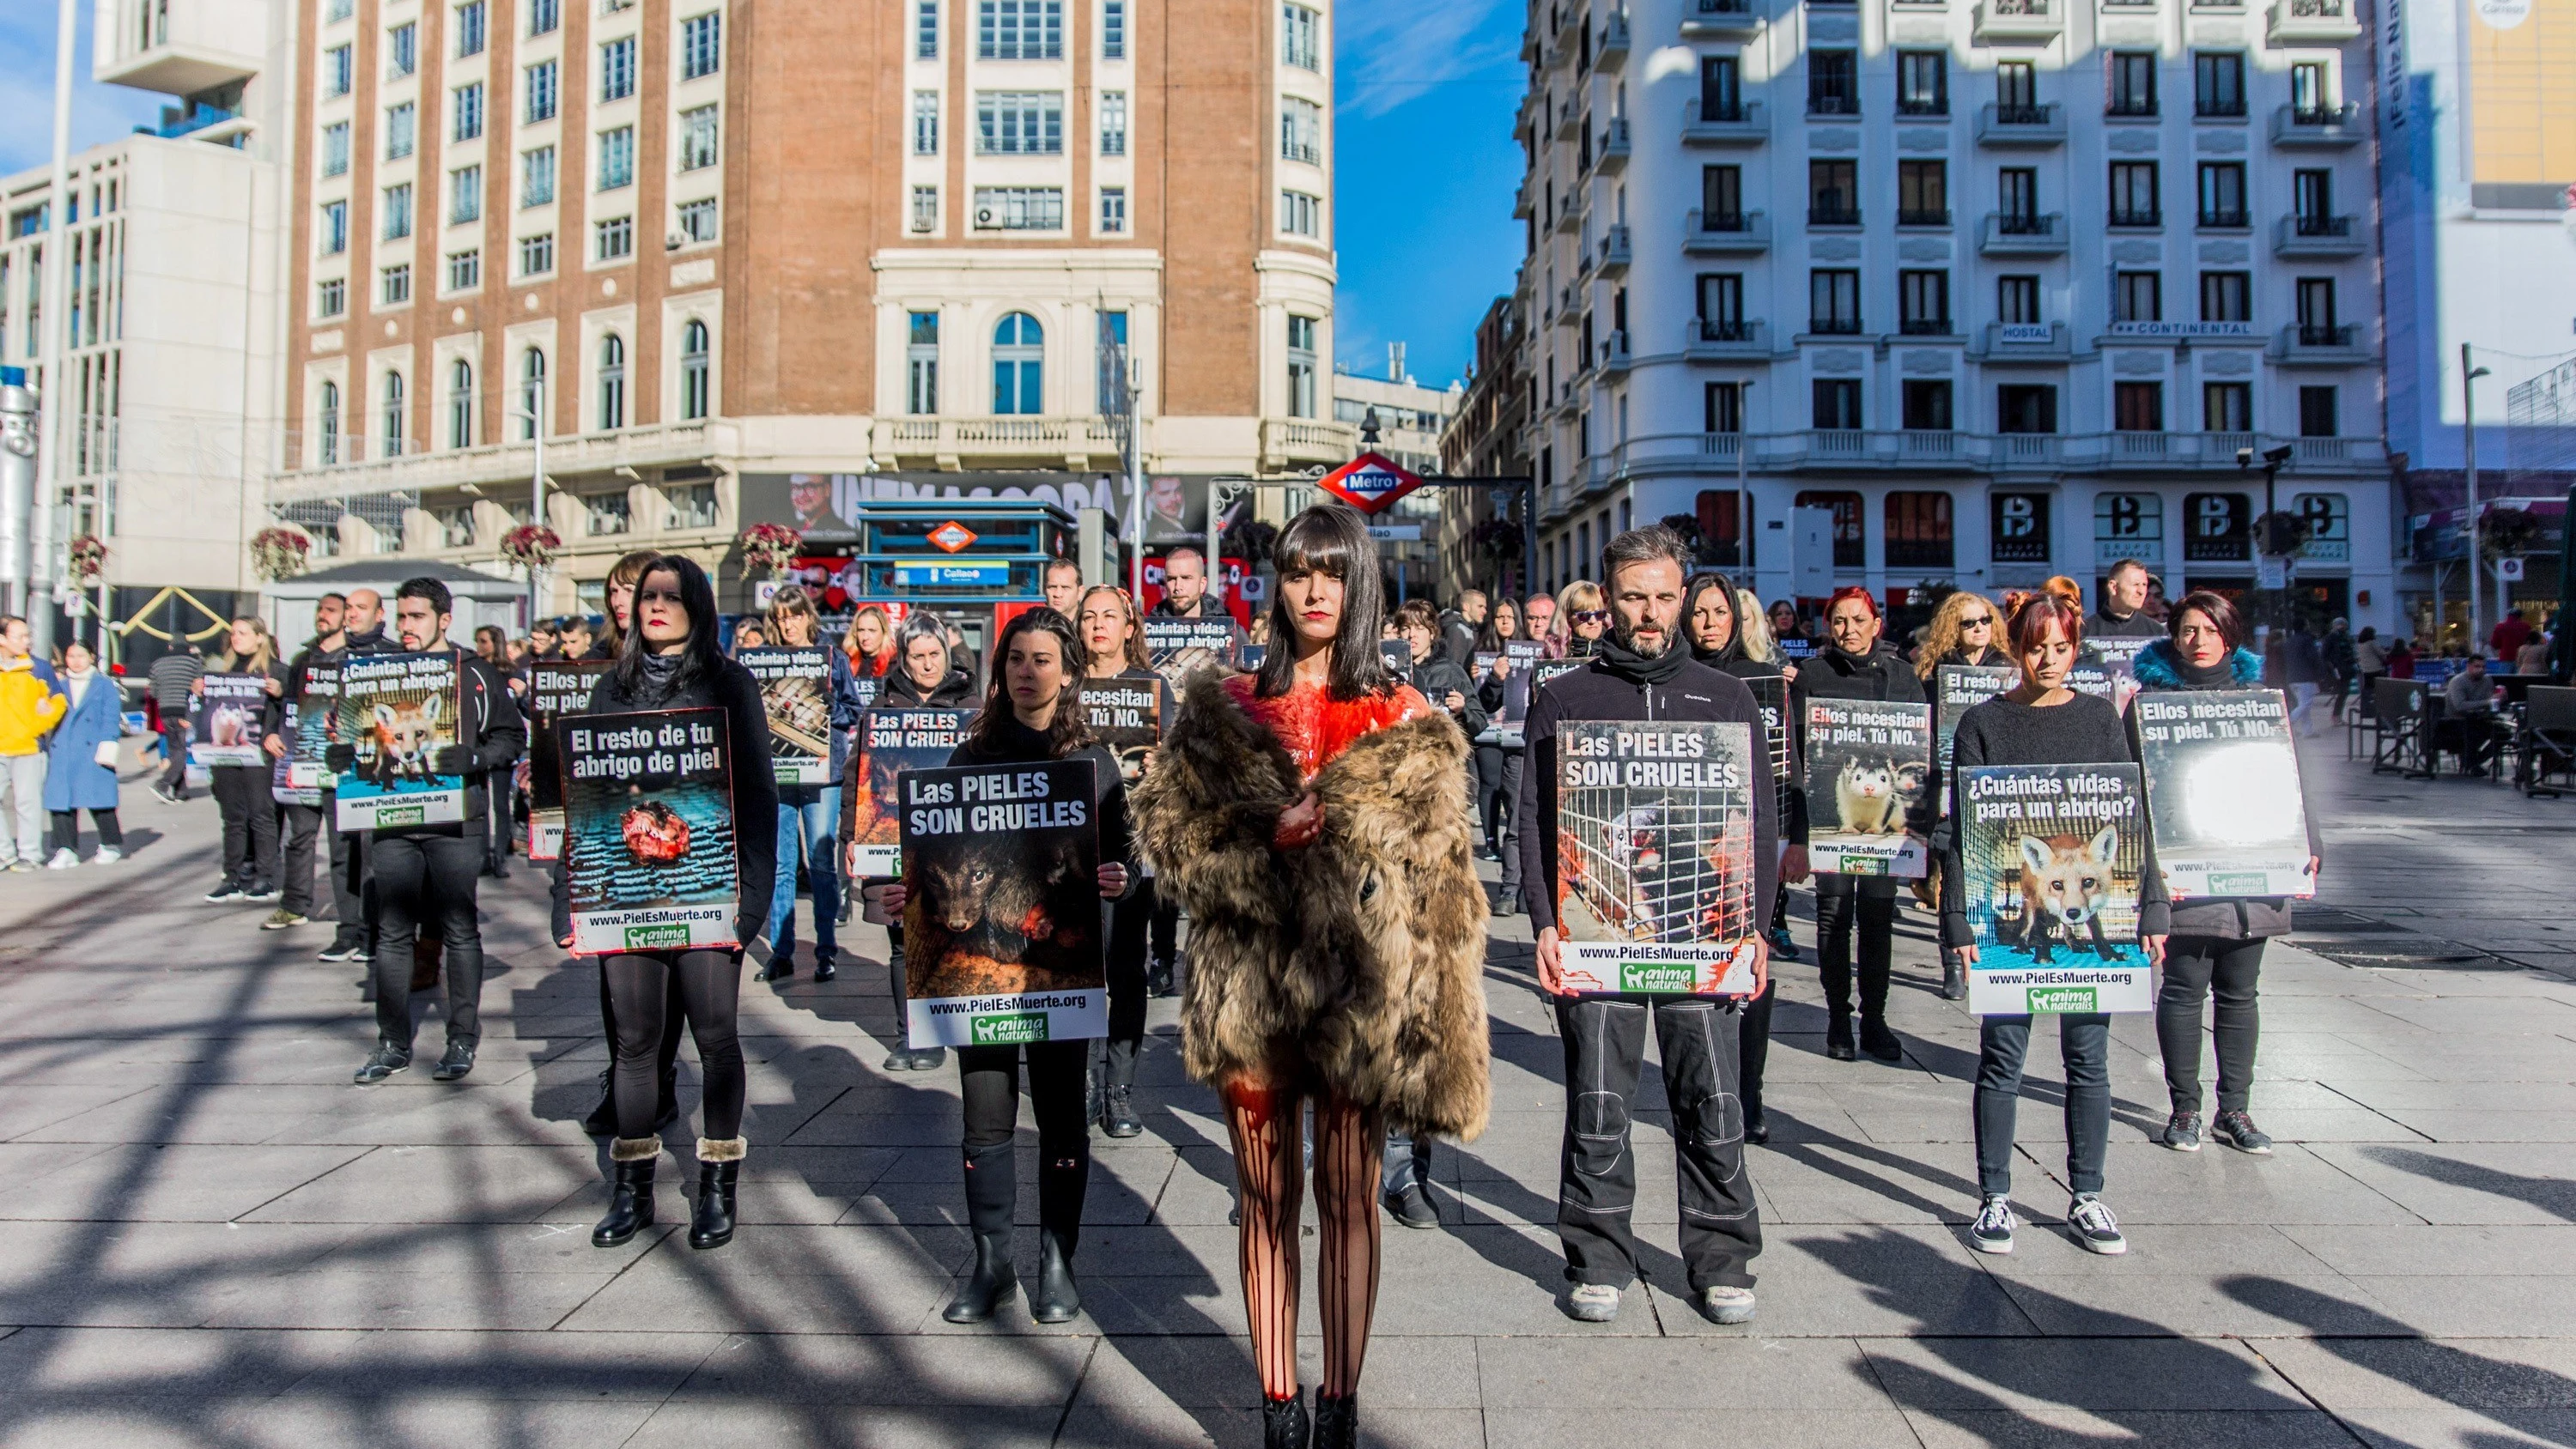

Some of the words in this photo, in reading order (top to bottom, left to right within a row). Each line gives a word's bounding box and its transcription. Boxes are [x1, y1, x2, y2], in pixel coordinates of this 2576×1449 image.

[2003, 327, 2049, 338] HOSTAL
[2138, 323, 2250, 334] CONTINENTAL
[1350, 476, 1393, 488] Metro
[1995, 543, 2044, 551] GRUPO
[1145, 622, 1191, 635] Cuántas
[1194, 621, 1226, 634] vidas
[1167, 637, 1183, 648] un
[1187, 635, 1233, 651] abrigo?
[1509, 645, 1534, 656] Ellos
[739, 652, 790, 668] ¿Cuántas
[792, 652, 823, 664] vidas
[341, 663, 407, 684] ¿Cuántas
[408, 658, 448, 674] vidas
[769, 667, 783, 677] un
[786, 664, 829, 678] abrigo?
[2074, 670, 2104, 681] vidas
[345, 681, 378, 698] para
[380, 678, 399, 691] un
[402, 671, 456, 691] abrigo?
[536, 671, 578, 690] Ellos
[1947, 673, 1961, 687] El
[1964, 675, 2001, 689] resto
[535, 694, 557, 711] su
[2142, 702, 2188, 720] Ellos
[2192, 700, 2282, 718] necesitan
[870, 713, 899, 730] Las
[902, 713, 958, 730] PIELES
[1090, 708, 1109, 727] Tú
[1114, 708, 1144, 727] NO.
[1810, 706, 1848, 724] Ellos
[1851, 710, 1926, 729] necesitan
[571, 729, 592, 752] El
[598, 727, 653, 750] resto
[659, 724, 685, 747] de
[690, 722, 714, 744] tu
[1809, 726, 1829, 741] su
[1832, 727, 1867, 745] piel.
[1868, 728, 1886, 743] Tú
[1891, 730, 1917, 746] NO.
[2145, 726, 2169, 741] su
[2173, 721, 2215, 743] piel.
[2216, 720, 2239, 738] Tú
[2243, 719, 2275, 737] NO.
[868, 731, 902, 748] SON
[1565, 732, 1610, 757] Las
[1617, 732, 1704, 758] PIELES
[574, 751, 642, 779] abrigo
[647, 749, 676, 773] de
[680, 747, 720, 776] piel
[1565, 761, 1618, 786] SON
[1625, 761, 1740, 789] CRUELES
[909, 779, 953, 805] Las
[962, 772, 1049, 803] PIELES
[1969, 776, 2063, 801] ¿Cuántas
[2067, 774, 2122, 795] vidas
[1977, 800, 2020, 823] para
[2027, 801, 2053, 816] un
[2058, 796, 2136, 822] abrigo?
[910, 808, 963, 836] SON
[970, 800, 1086, 832] CRUELES
[1815, 844, 1914, 858] www.PielEsMuerte.org
[1856, 858, 1886, 868] anima
[2227, 874, 2264, 886] anima
[590, 908, 722, 926] www.PielEsMuerte.org
[647, 928, 686, 940] anima
[647, 937, 688, 949] naturalis
[1580, 946, 1735, 962] www.PielEsMuerte.org
[1645, 966, 1692, 980] anima
[1989, 972, 2132, 985] www.PielEsMuerte.org
[1645, 978, 1692, 991] naturalis
[929, 993, 1086, 1015] www.PielEsMuerte.org
[2050, 990, 2092, 1002] anima
[2050, 999, 2093, 1011] naturalis
[997, 1017, 1044, 1031] anima
[997, 1028, 1045, 1042] naturalis
